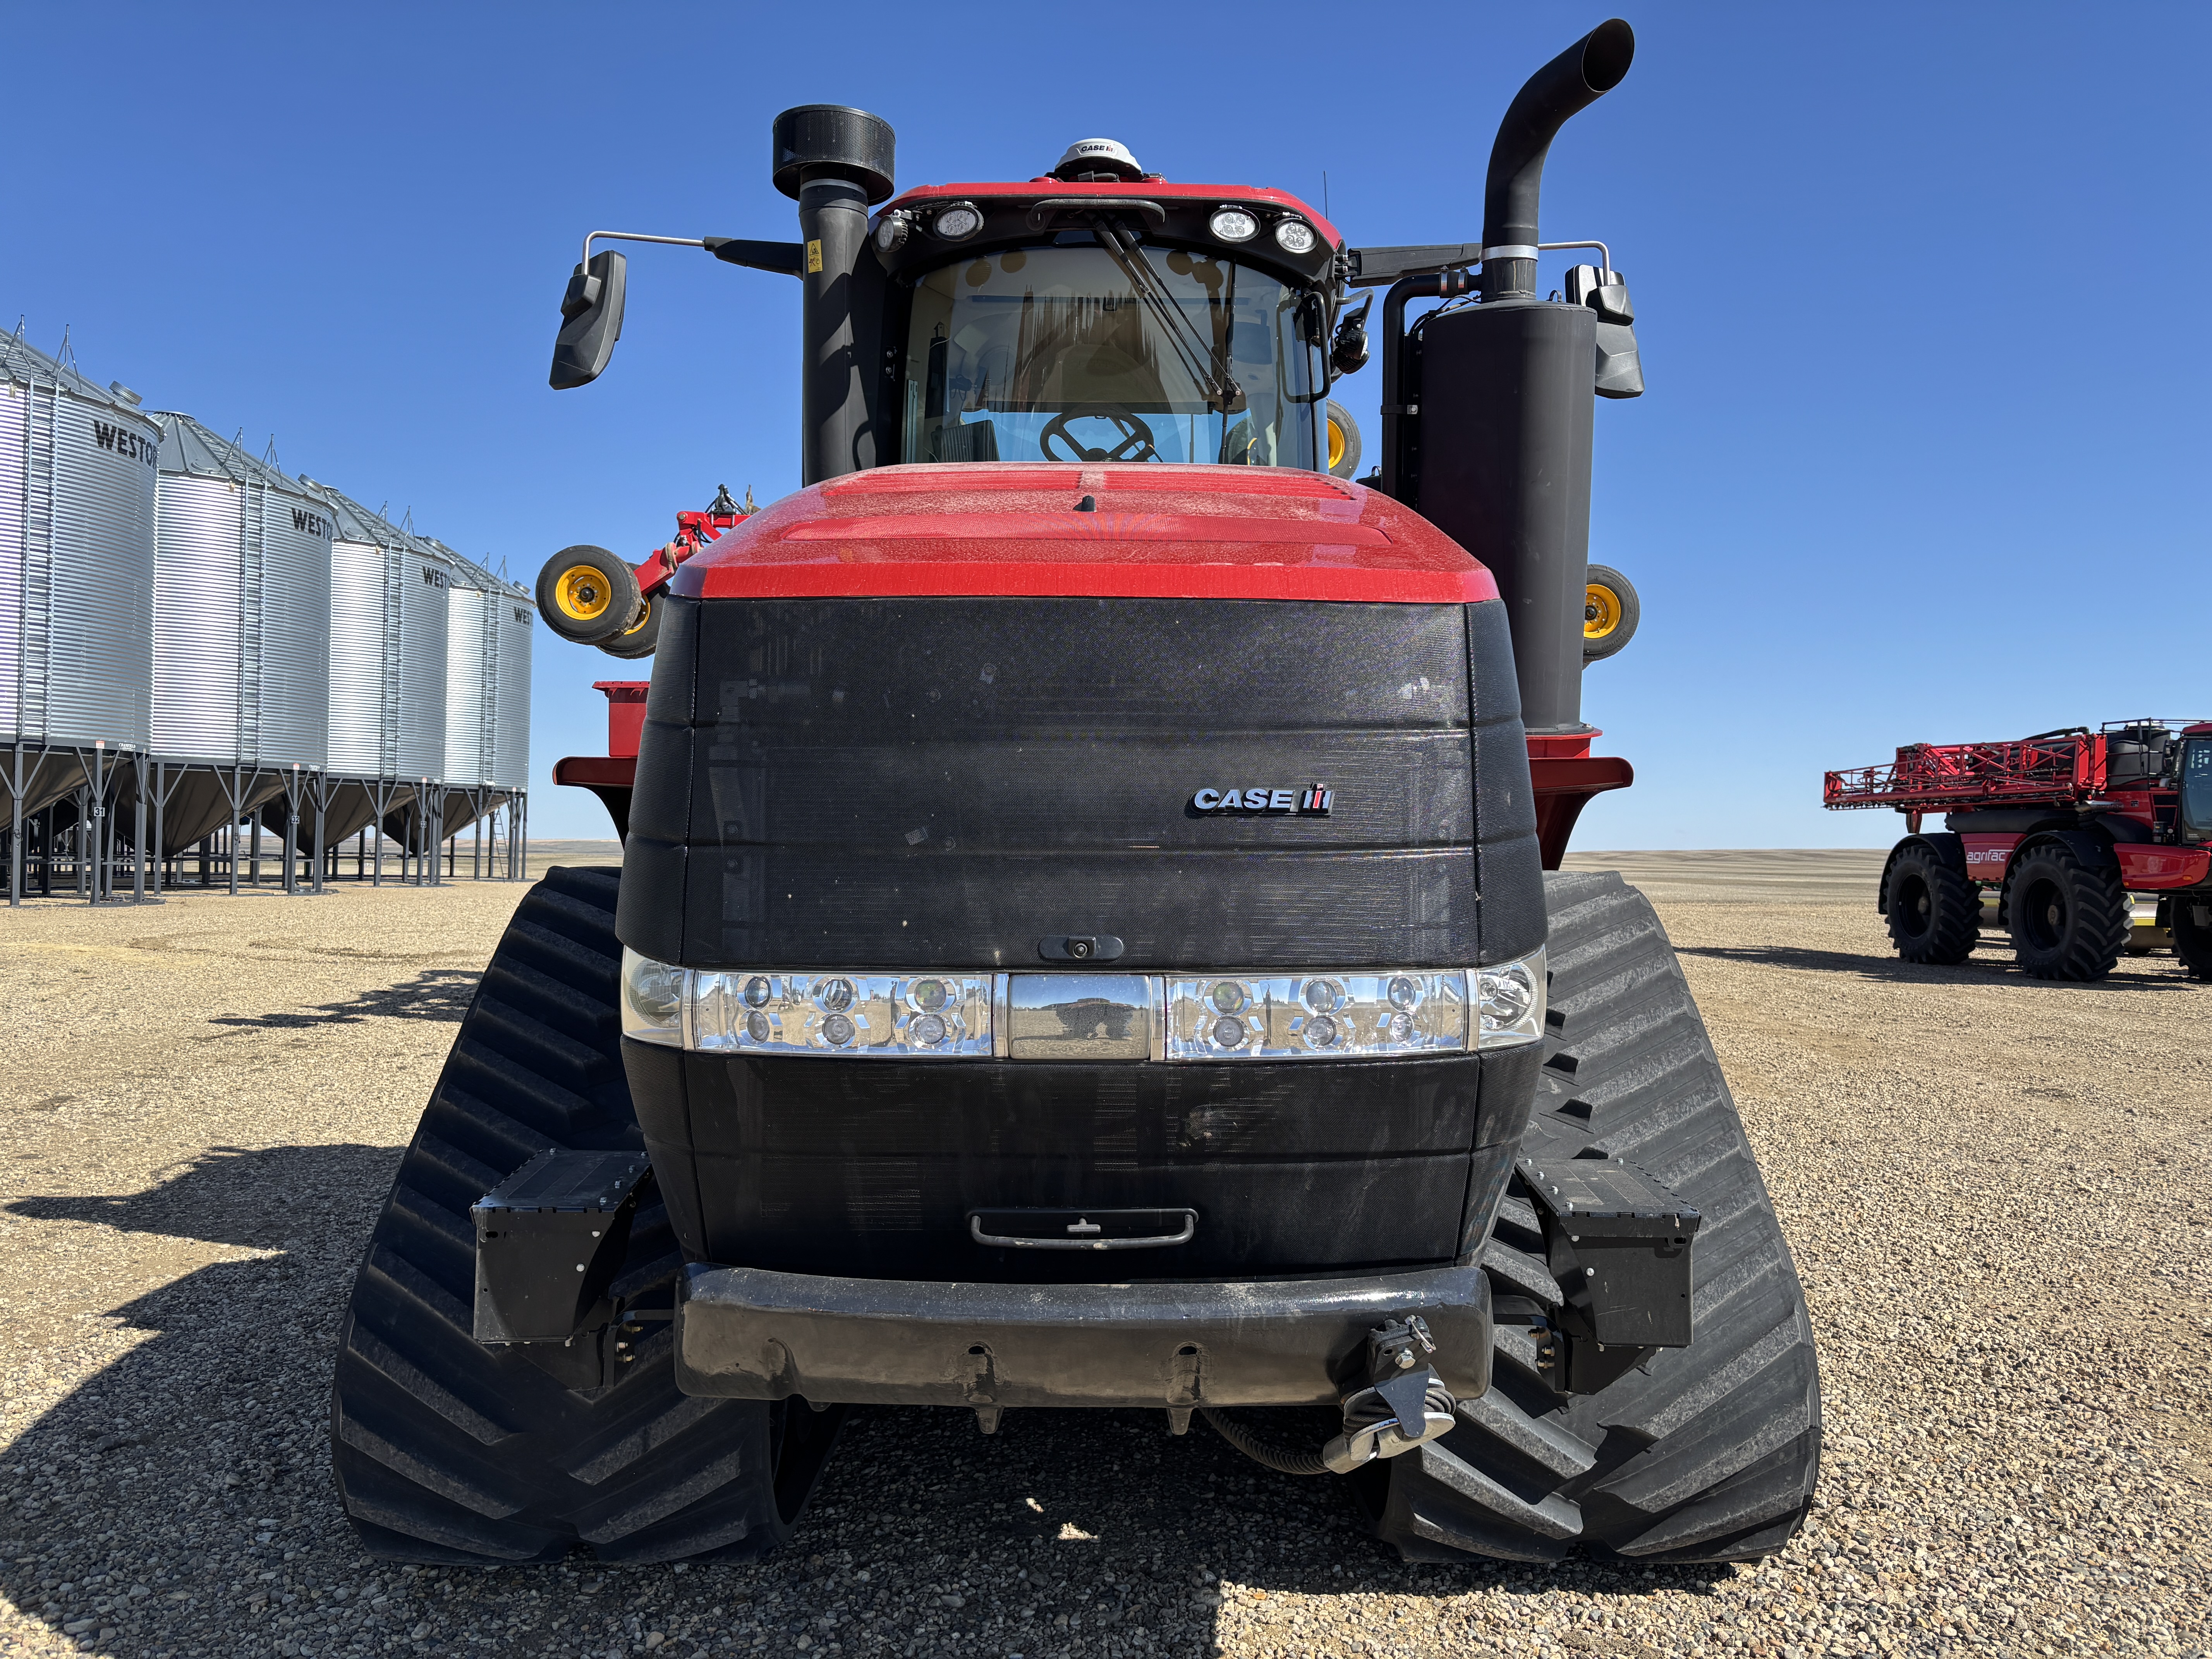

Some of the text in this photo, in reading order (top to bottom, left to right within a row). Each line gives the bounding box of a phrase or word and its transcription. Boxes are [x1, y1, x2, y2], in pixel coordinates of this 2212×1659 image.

[1194, 788, 1295, 809] CASE
[95, 807, 103, 816] 31
[1966, 849, 2014, 864] agrifac
